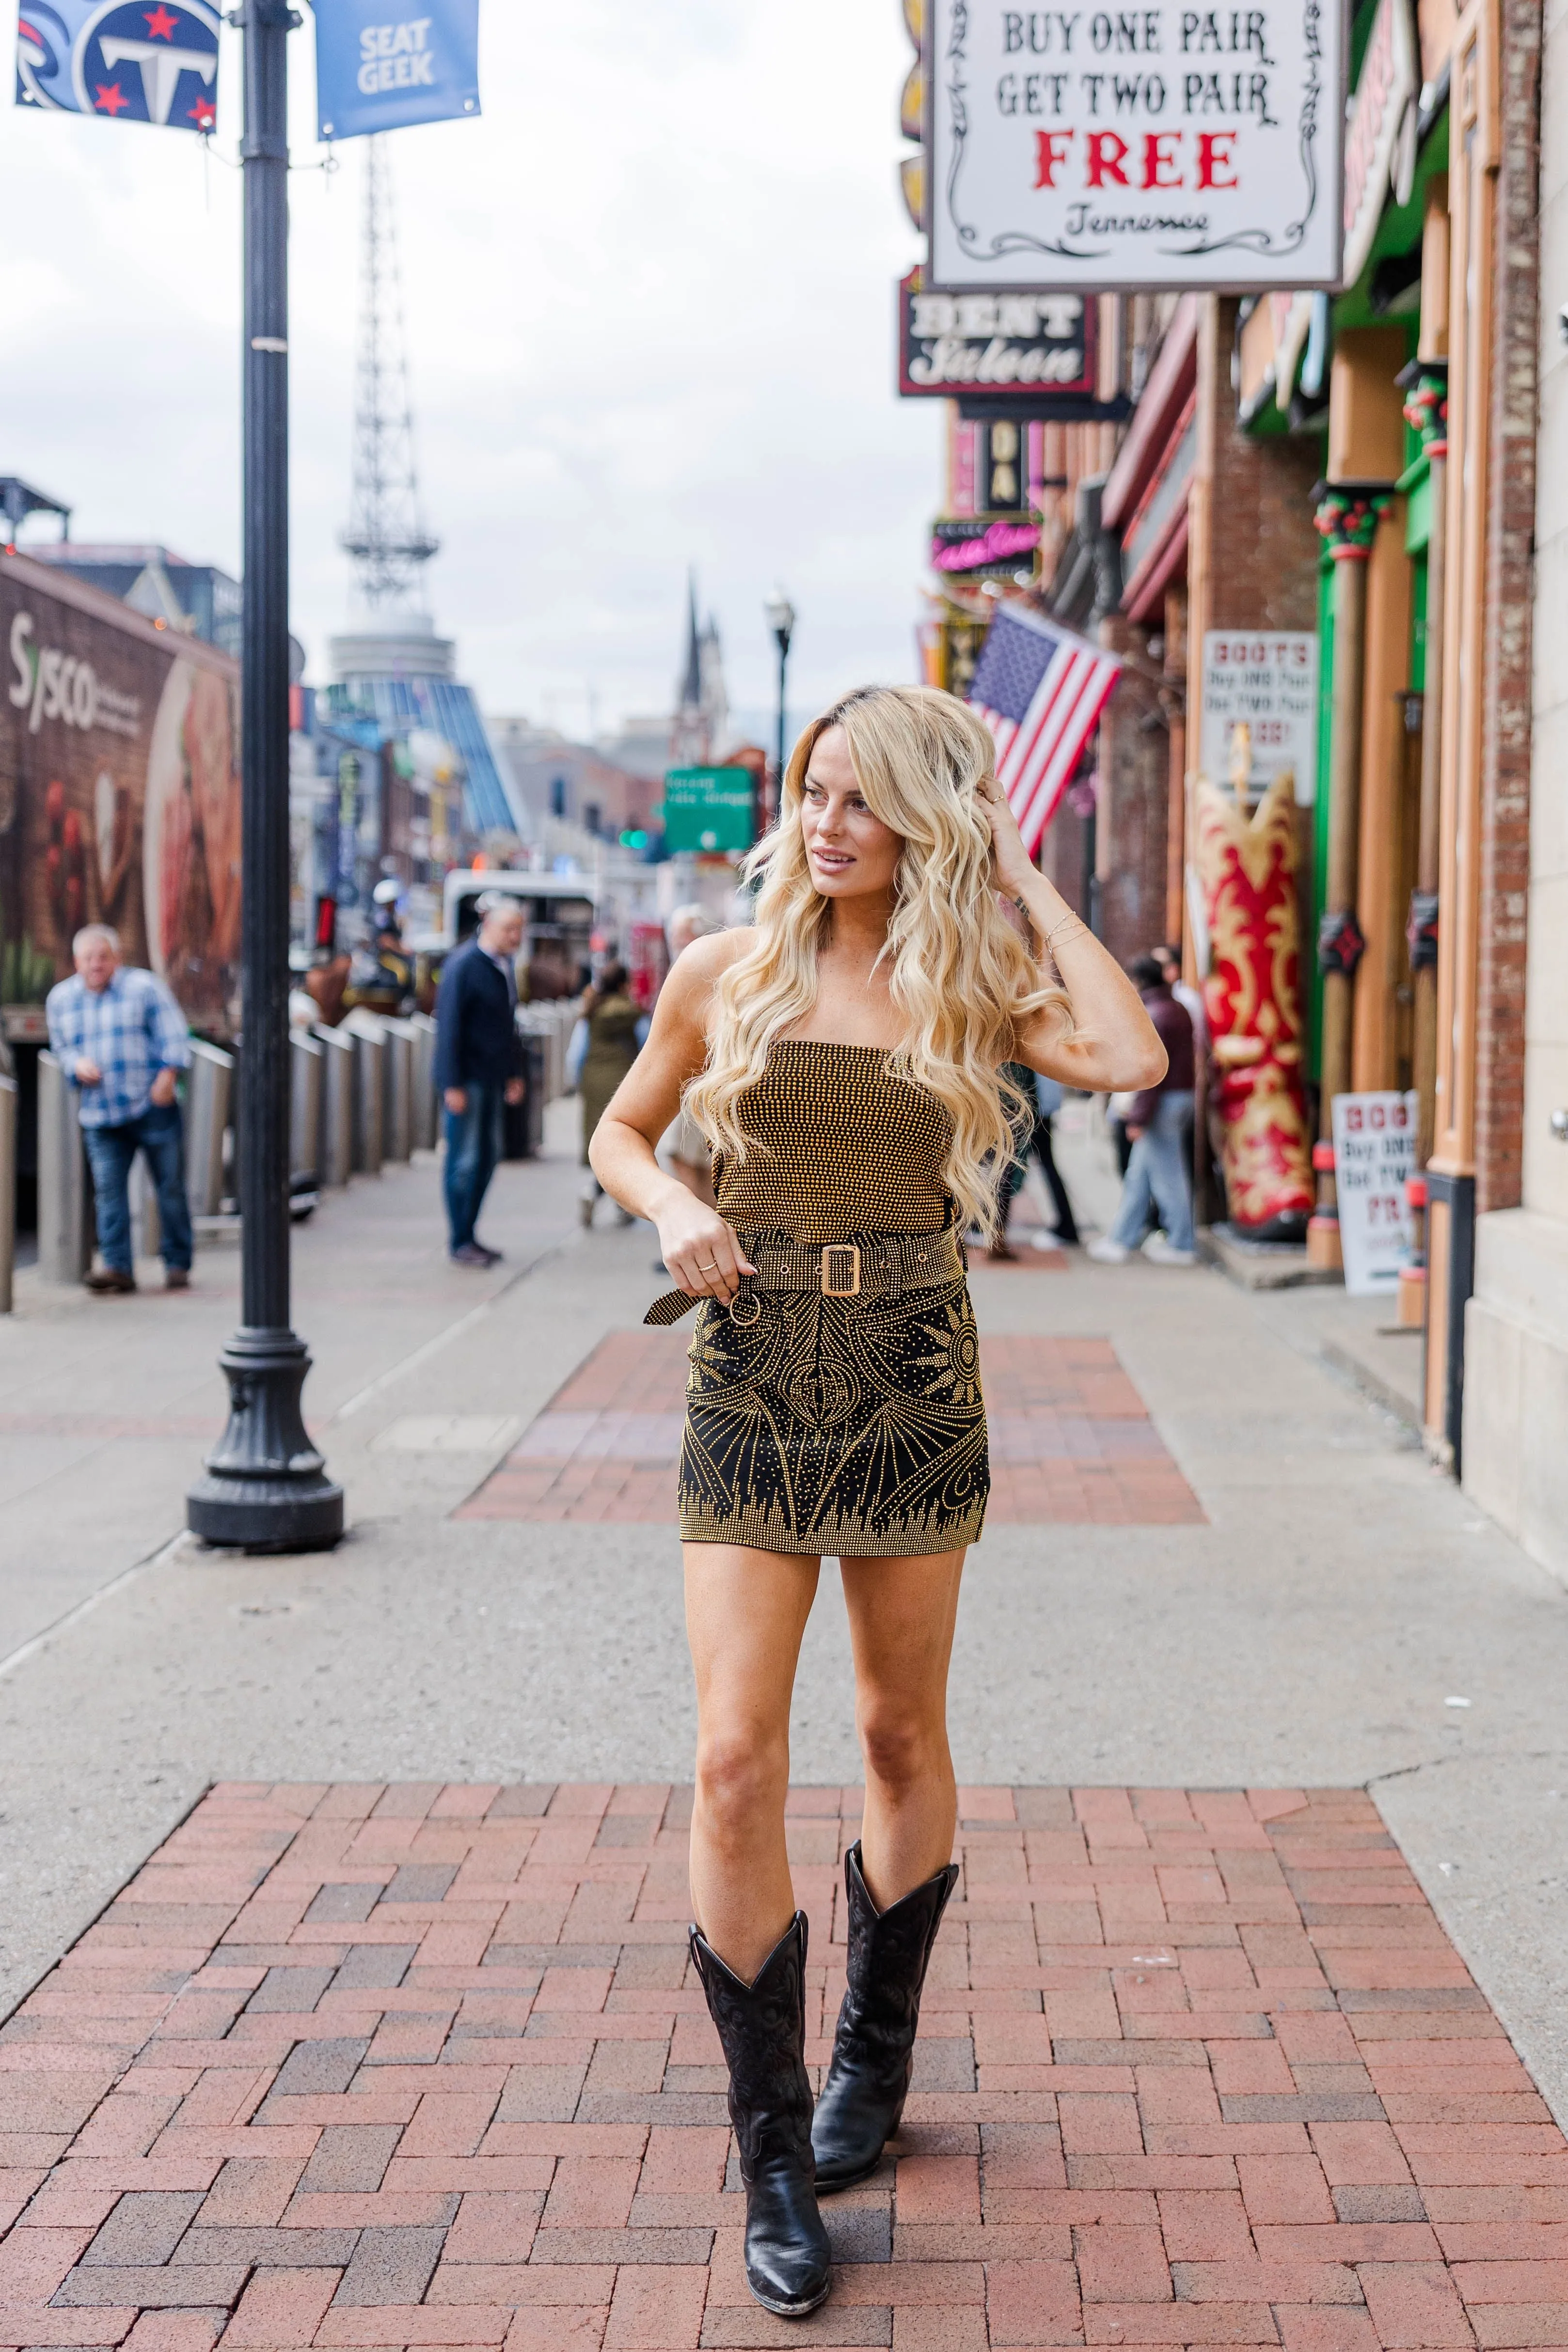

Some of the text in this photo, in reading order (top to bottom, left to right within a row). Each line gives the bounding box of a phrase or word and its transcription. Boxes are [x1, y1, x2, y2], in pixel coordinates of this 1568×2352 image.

[359, 17, 432, 61] SEAT
[1001, 11, 1277, 65] BUY ONE PAIR
[357, 51, 435, 95] GEEK
[997, 72, 1280, 125] GET TWO PAIR
[1032, 127, 1238, 190] FREE
[1215, 641, 1307, 668] BOOTS
[1346, 1105, 1409, 1131] BOO
[1380, 1165, 1408, 1184] TW
